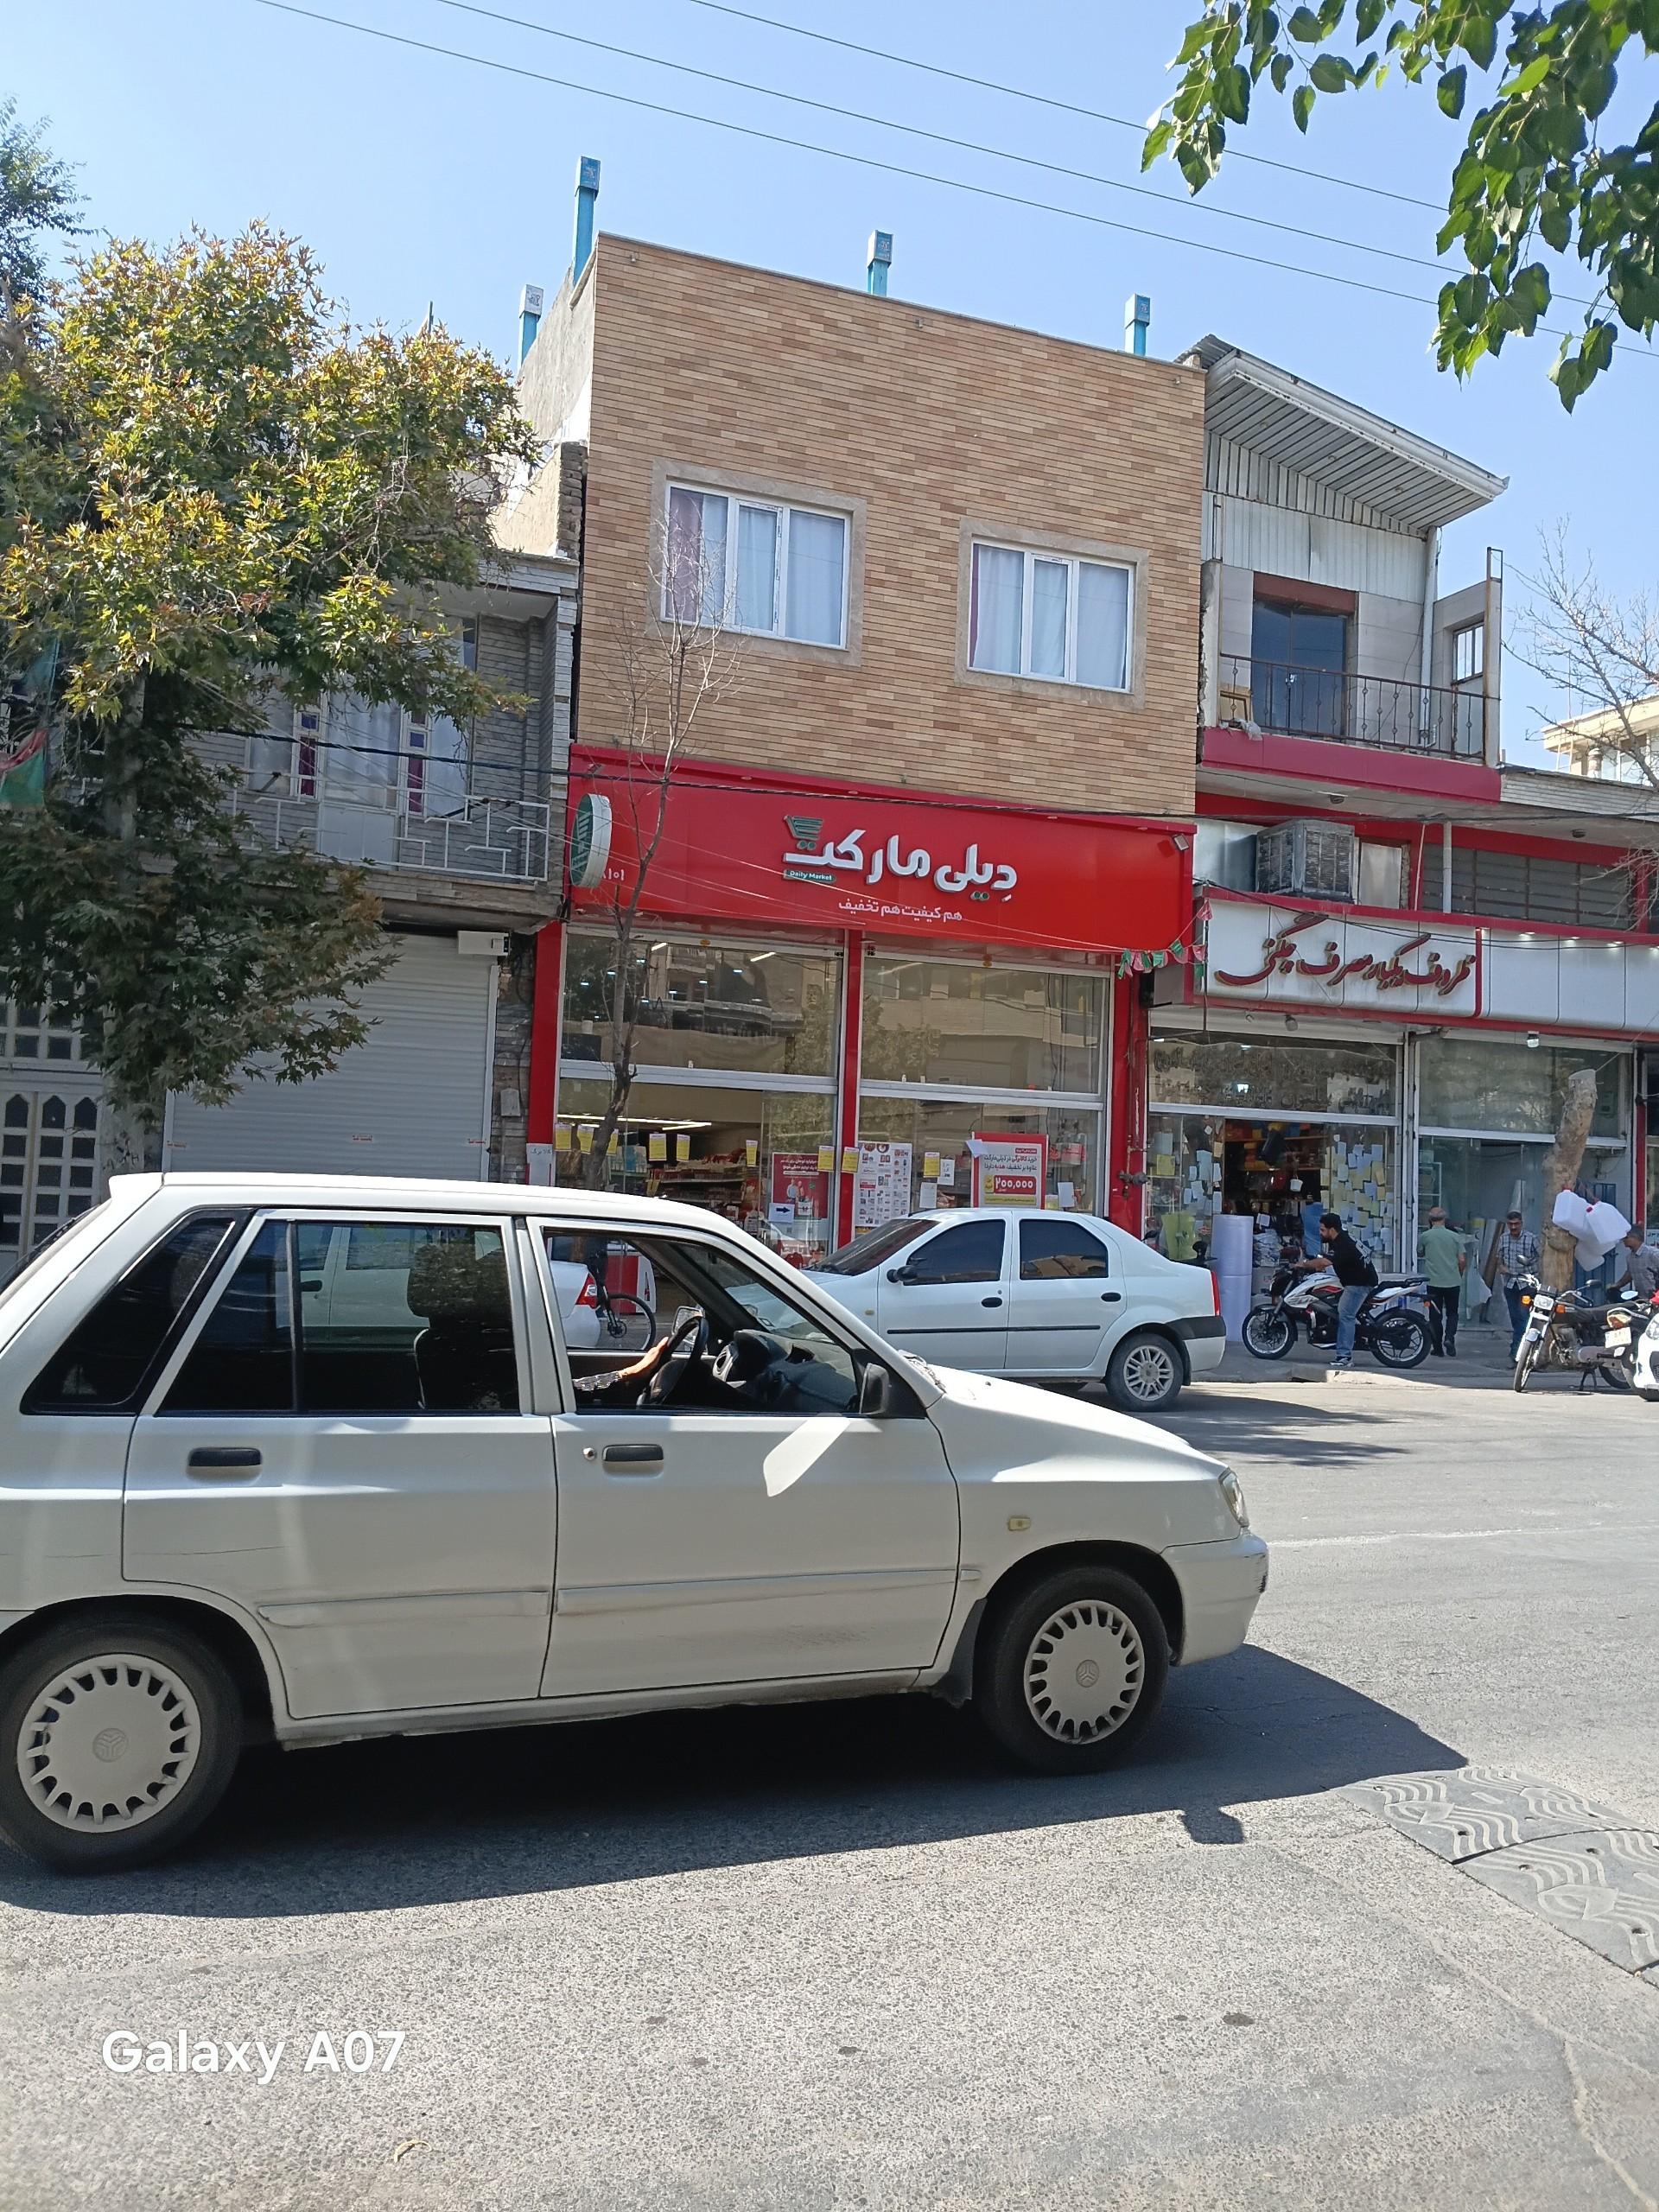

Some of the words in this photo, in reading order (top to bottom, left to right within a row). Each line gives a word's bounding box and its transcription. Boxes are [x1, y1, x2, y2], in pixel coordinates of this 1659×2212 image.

[783, 829, 931, 885] مارکت
[790, 870, 808, 879] Daily
[809, 873, 832, 881] Market
[838, 898, 880, 915] تخفیف
[880, 905, 900, 917] هم
[901, 906, 942, 923] کیفیت
[943, 911, 963, 923] هم
[1296, 940, 1374, 987] مصرف
[1403, 951, 1477, 996] ظروف
